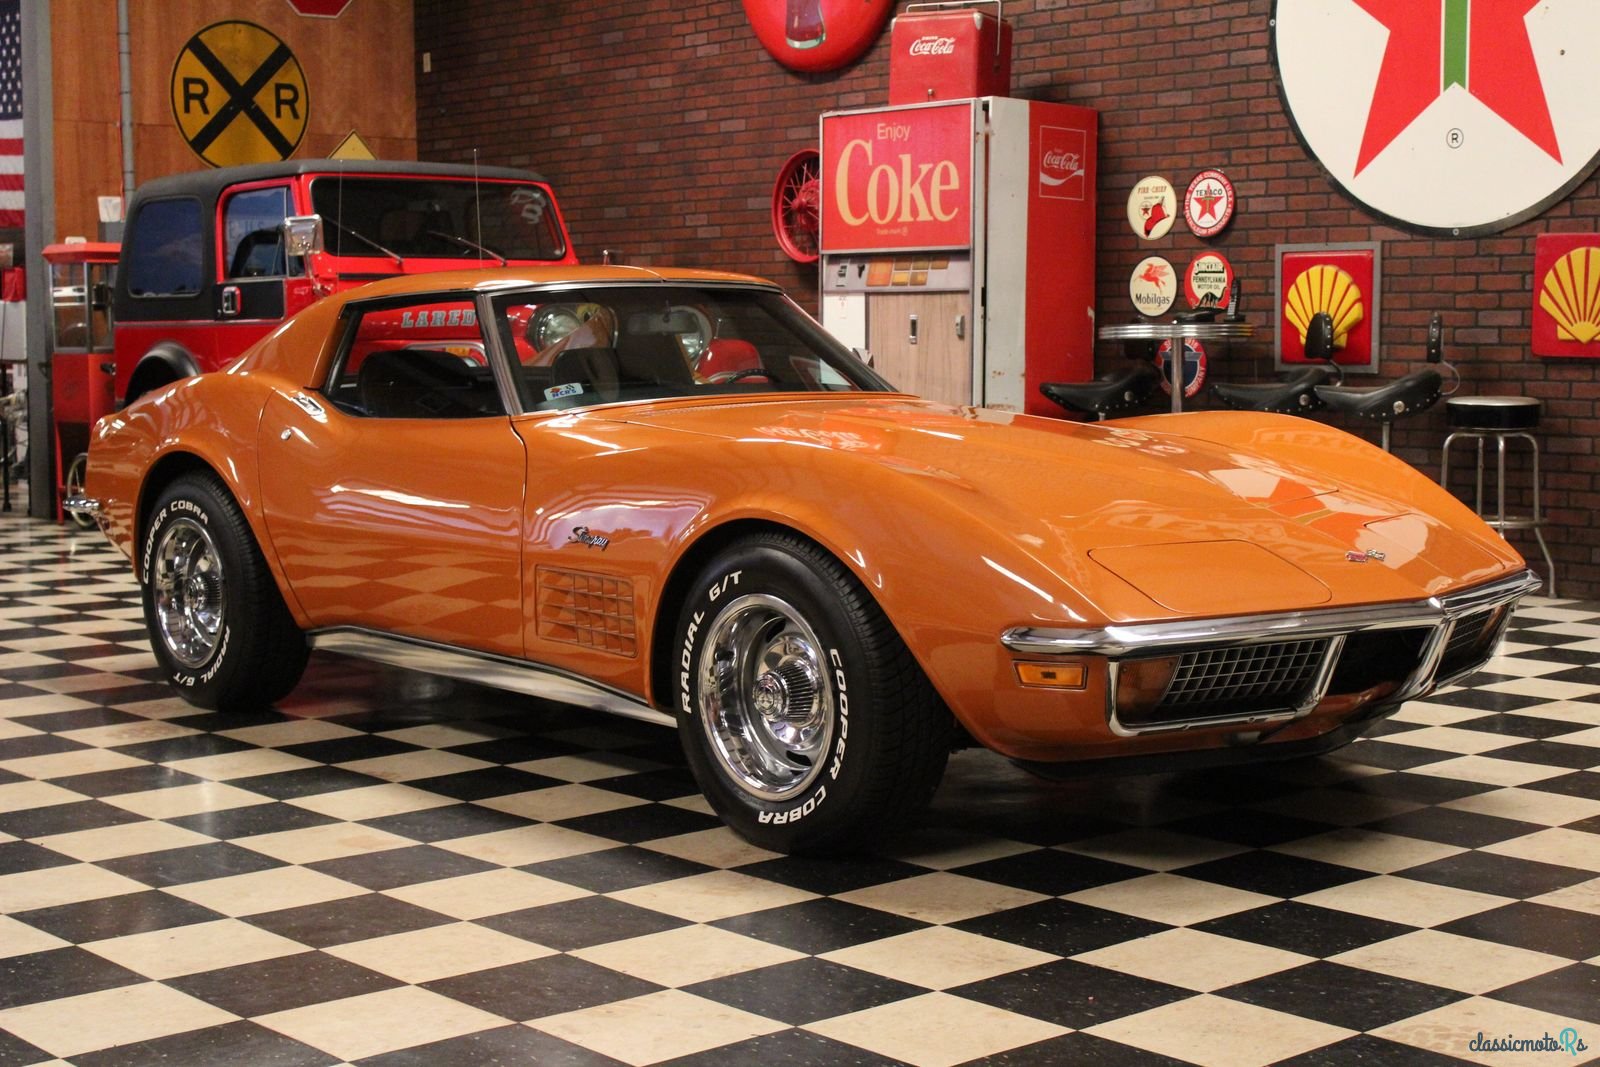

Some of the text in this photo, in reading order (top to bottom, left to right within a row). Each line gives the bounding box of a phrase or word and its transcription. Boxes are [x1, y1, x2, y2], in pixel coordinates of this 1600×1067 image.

[183, 77, 300, 120] R R
[877, 122, 911, 141] Enjoy
[836, 138, 960, 227] Coke
[1196, 189, 1223, 197] TEXACO
[401, 309, 477, 328] LARED
[1136, 293, 1170, 307] Mobilgas
[143, 500, 209, 584] COOPER COBRA
[173, 625, 231, 686] RADIAL G/T
[680, 570, 742, 714] RADIAL G/T
[758, 648, 849, 825] COOPER COBRA
